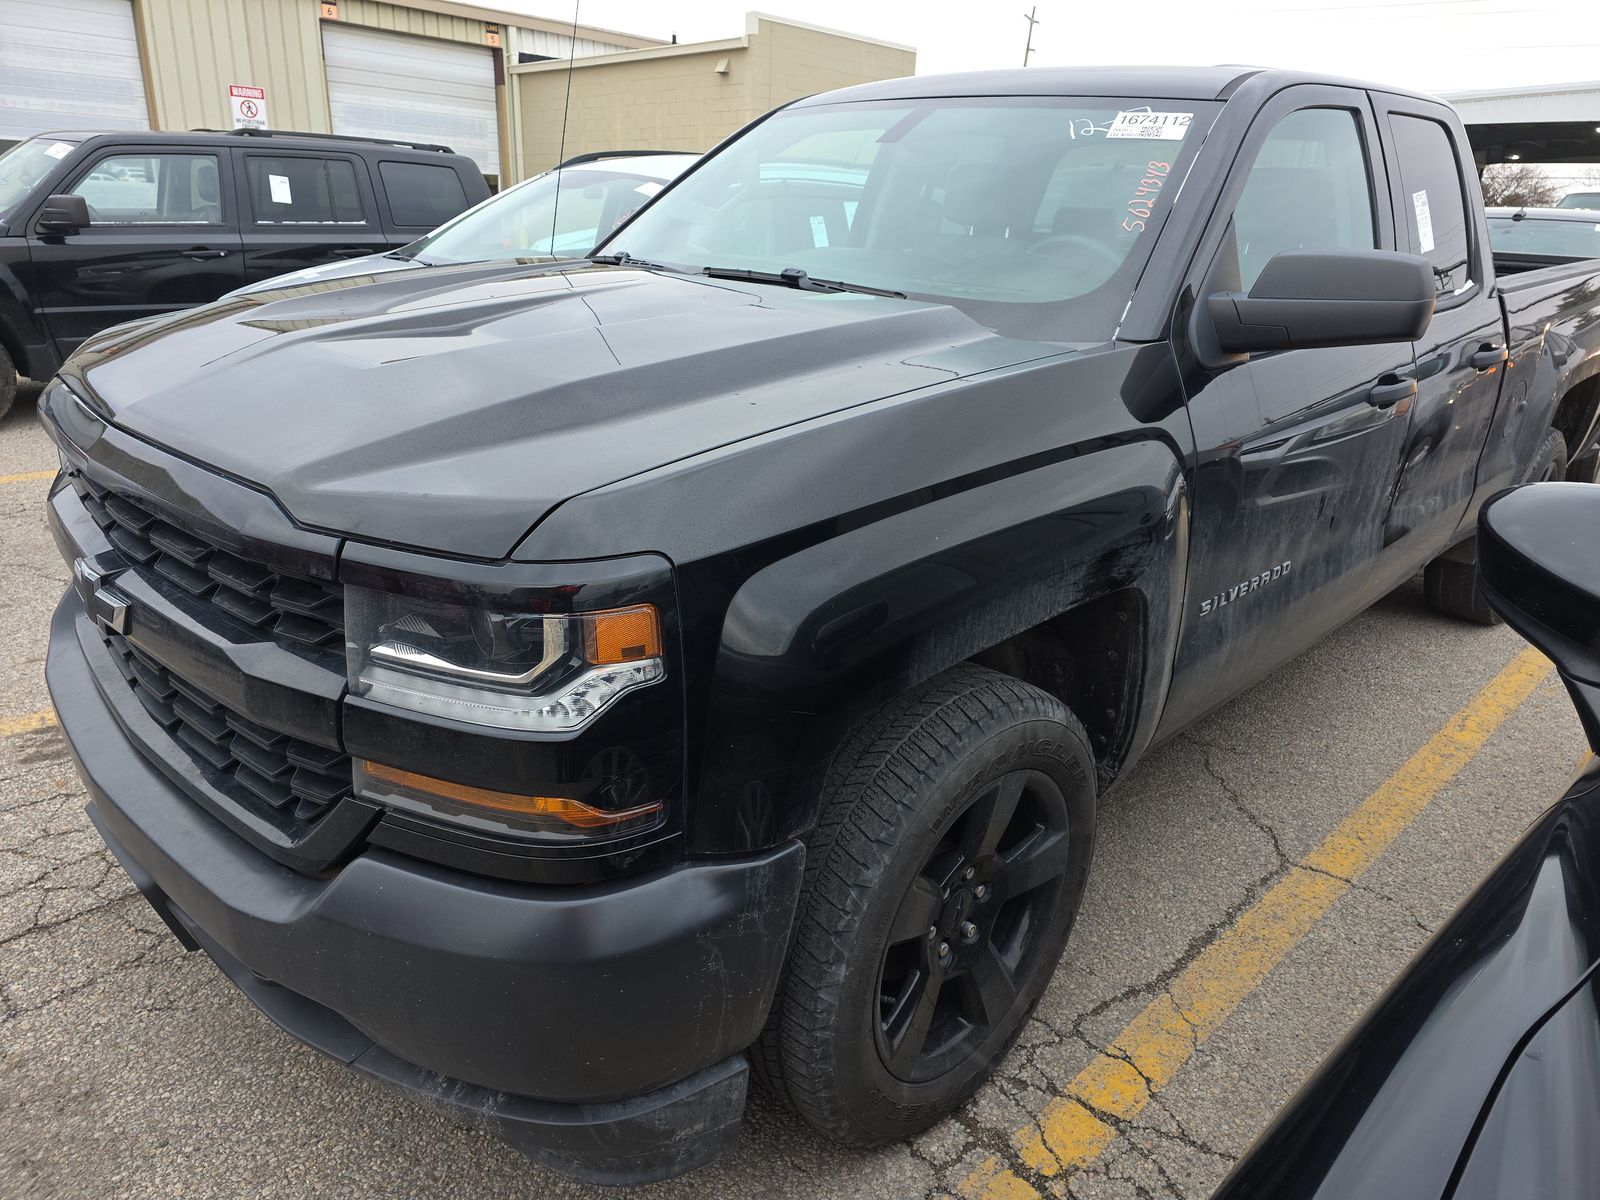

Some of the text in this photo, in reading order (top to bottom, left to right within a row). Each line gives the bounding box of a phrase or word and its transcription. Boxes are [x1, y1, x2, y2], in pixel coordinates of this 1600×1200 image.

[327, 7, 333, 16] 6
[490, 35, 496, 44] 5
[232, 87, 262, 98] WARNING
[1120, 114, 1192, 127] 1674112
[1199, 560, 1292, 617] SILVERADO
